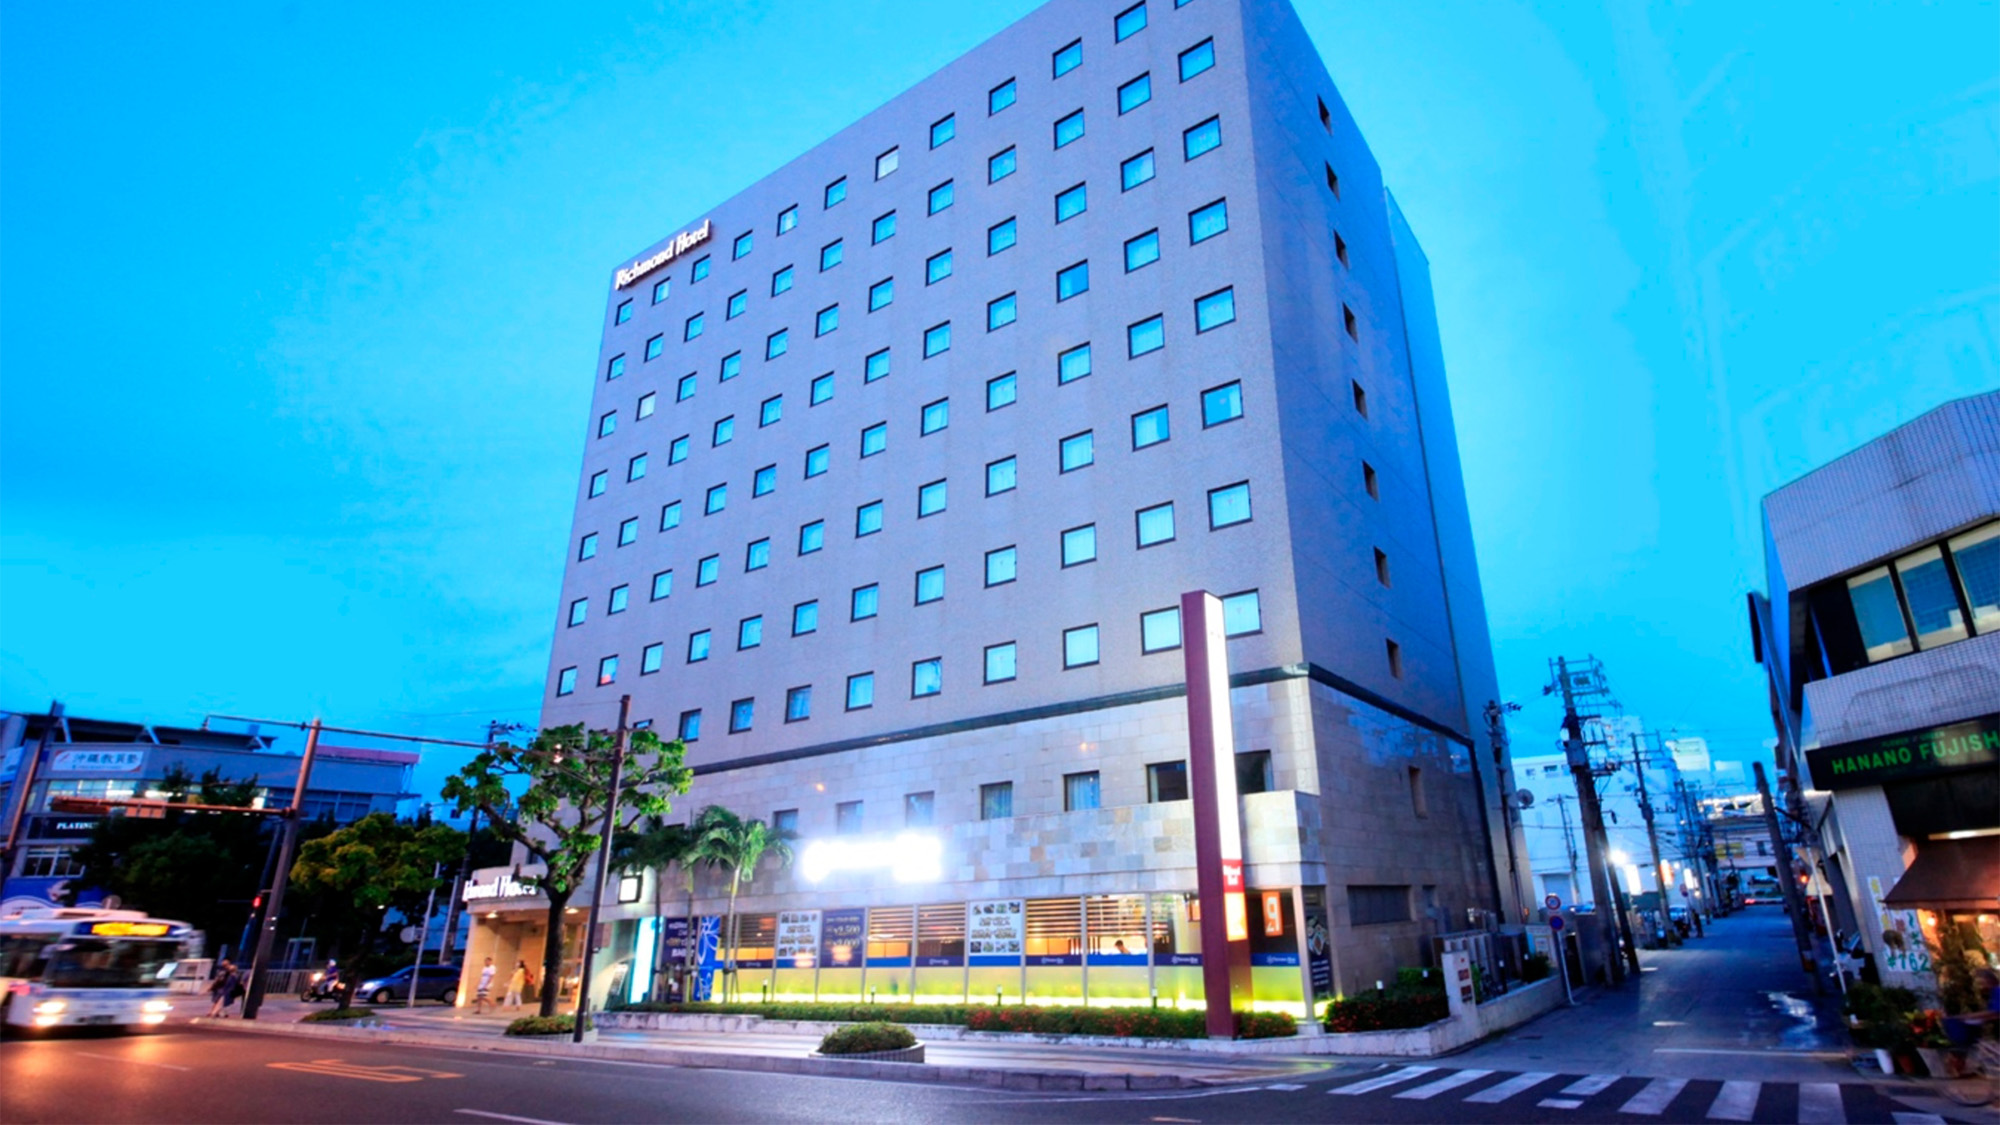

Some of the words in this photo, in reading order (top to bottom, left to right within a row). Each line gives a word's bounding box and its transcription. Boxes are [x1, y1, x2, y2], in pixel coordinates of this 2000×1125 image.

[615, 239, 675, 290] Richmond
[675, 218, 711, 255] Hotel
[1831, 747, 1912, 775] HANANO
